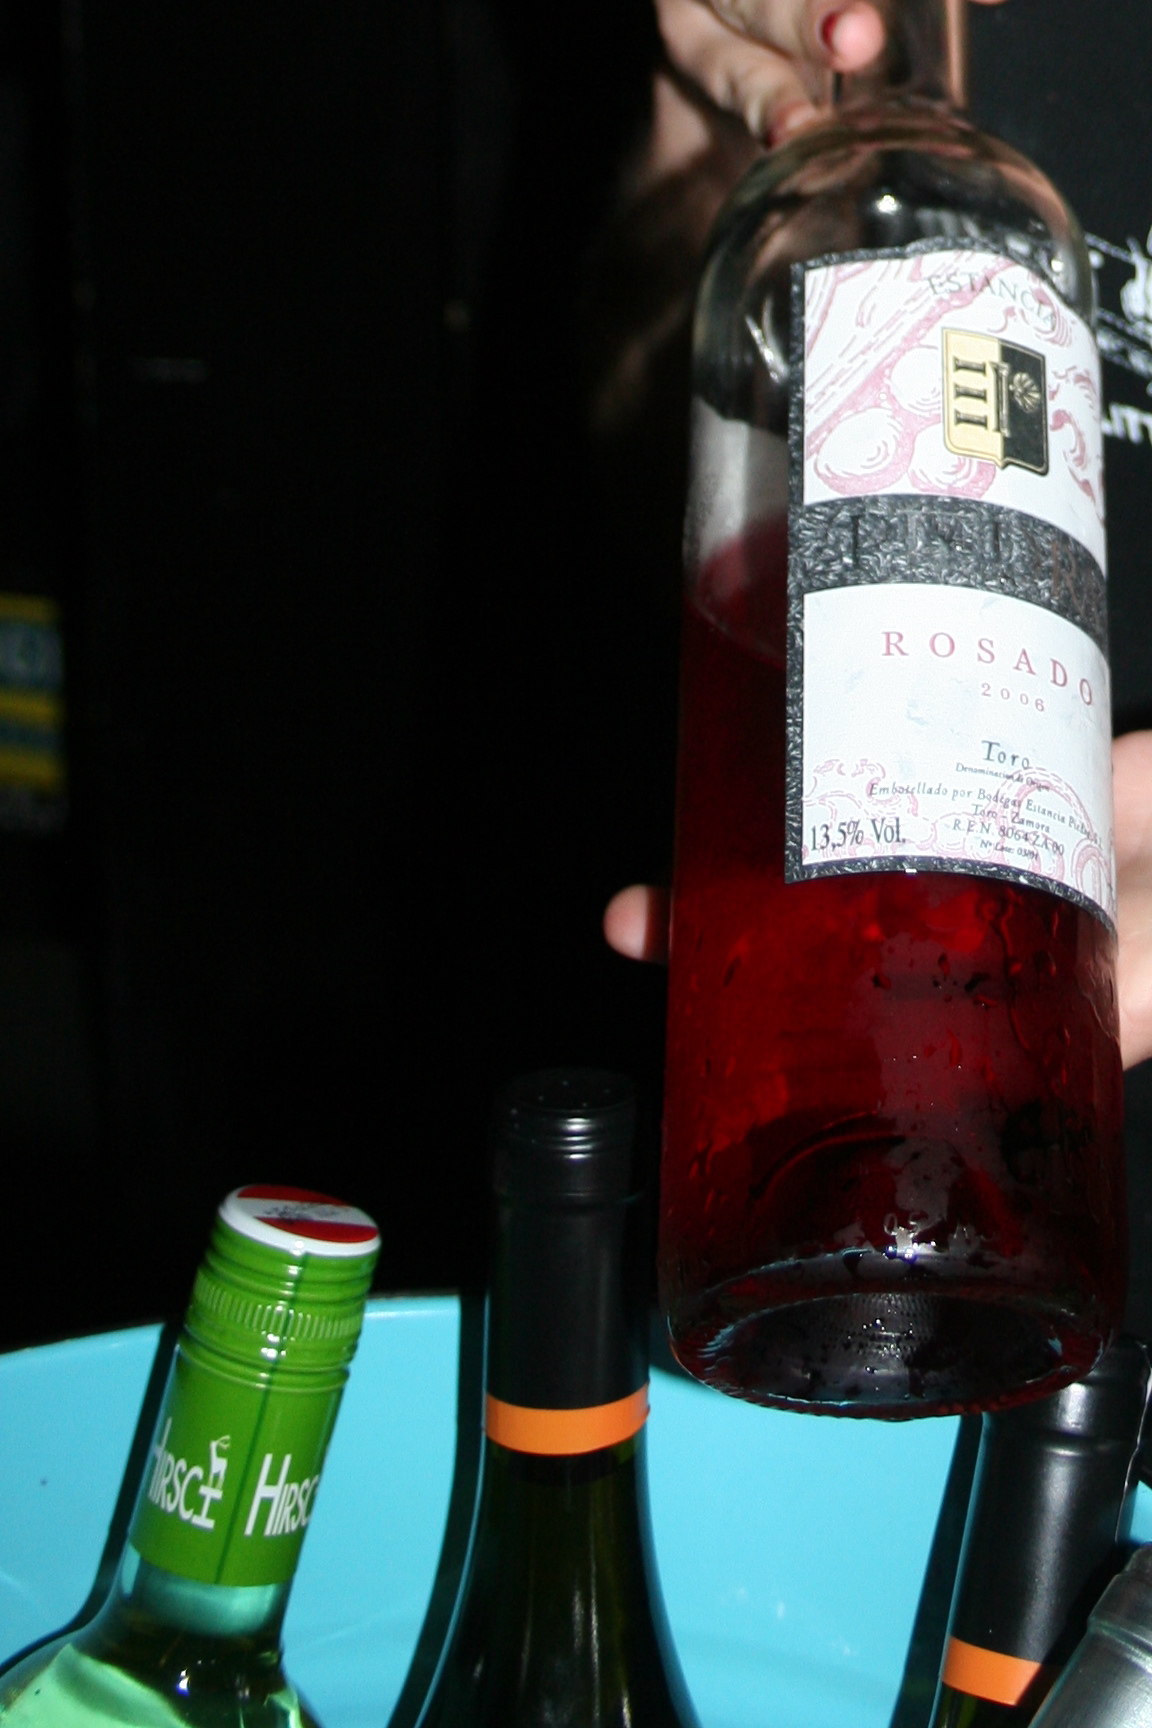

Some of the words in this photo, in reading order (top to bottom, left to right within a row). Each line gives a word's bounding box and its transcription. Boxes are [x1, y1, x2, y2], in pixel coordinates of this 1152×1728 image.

[881, 631, 1093, 706] ROSADO
[981, 682, 1045, 712] 2006
[981, 740, 1030, 770] Toro
[869, 781, 948, 797] Embotellado
[951, 788, 973, 801] por
[811, 819, 864, 851] 13,5%
[870, 816, 906, 844] Vol.
[972, 803, 998, 819] Toro
[1011, 811, 1050, 834] Zamora
